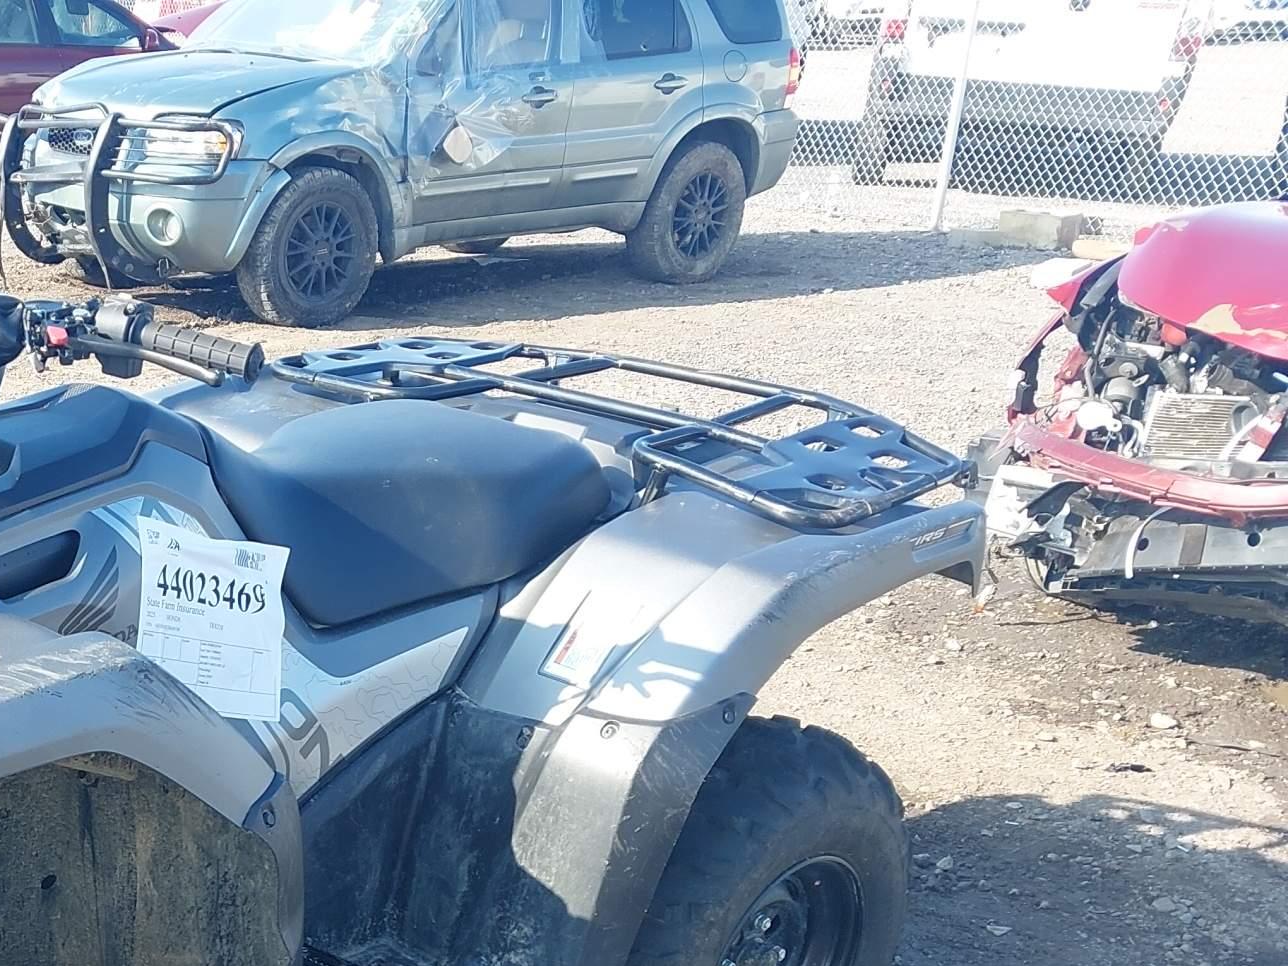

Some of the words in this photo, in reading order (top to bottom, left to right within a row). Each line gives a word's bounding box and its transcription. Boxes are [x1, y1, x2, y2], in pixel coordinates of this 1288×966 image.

[915, 528, 946, 545] IRS
[156, 563, 266, 614] 44023469
[146, 596, 160, 608] State
[161, 600, 175, 611] Farm
[176, 602, 205, 616] Insurance
